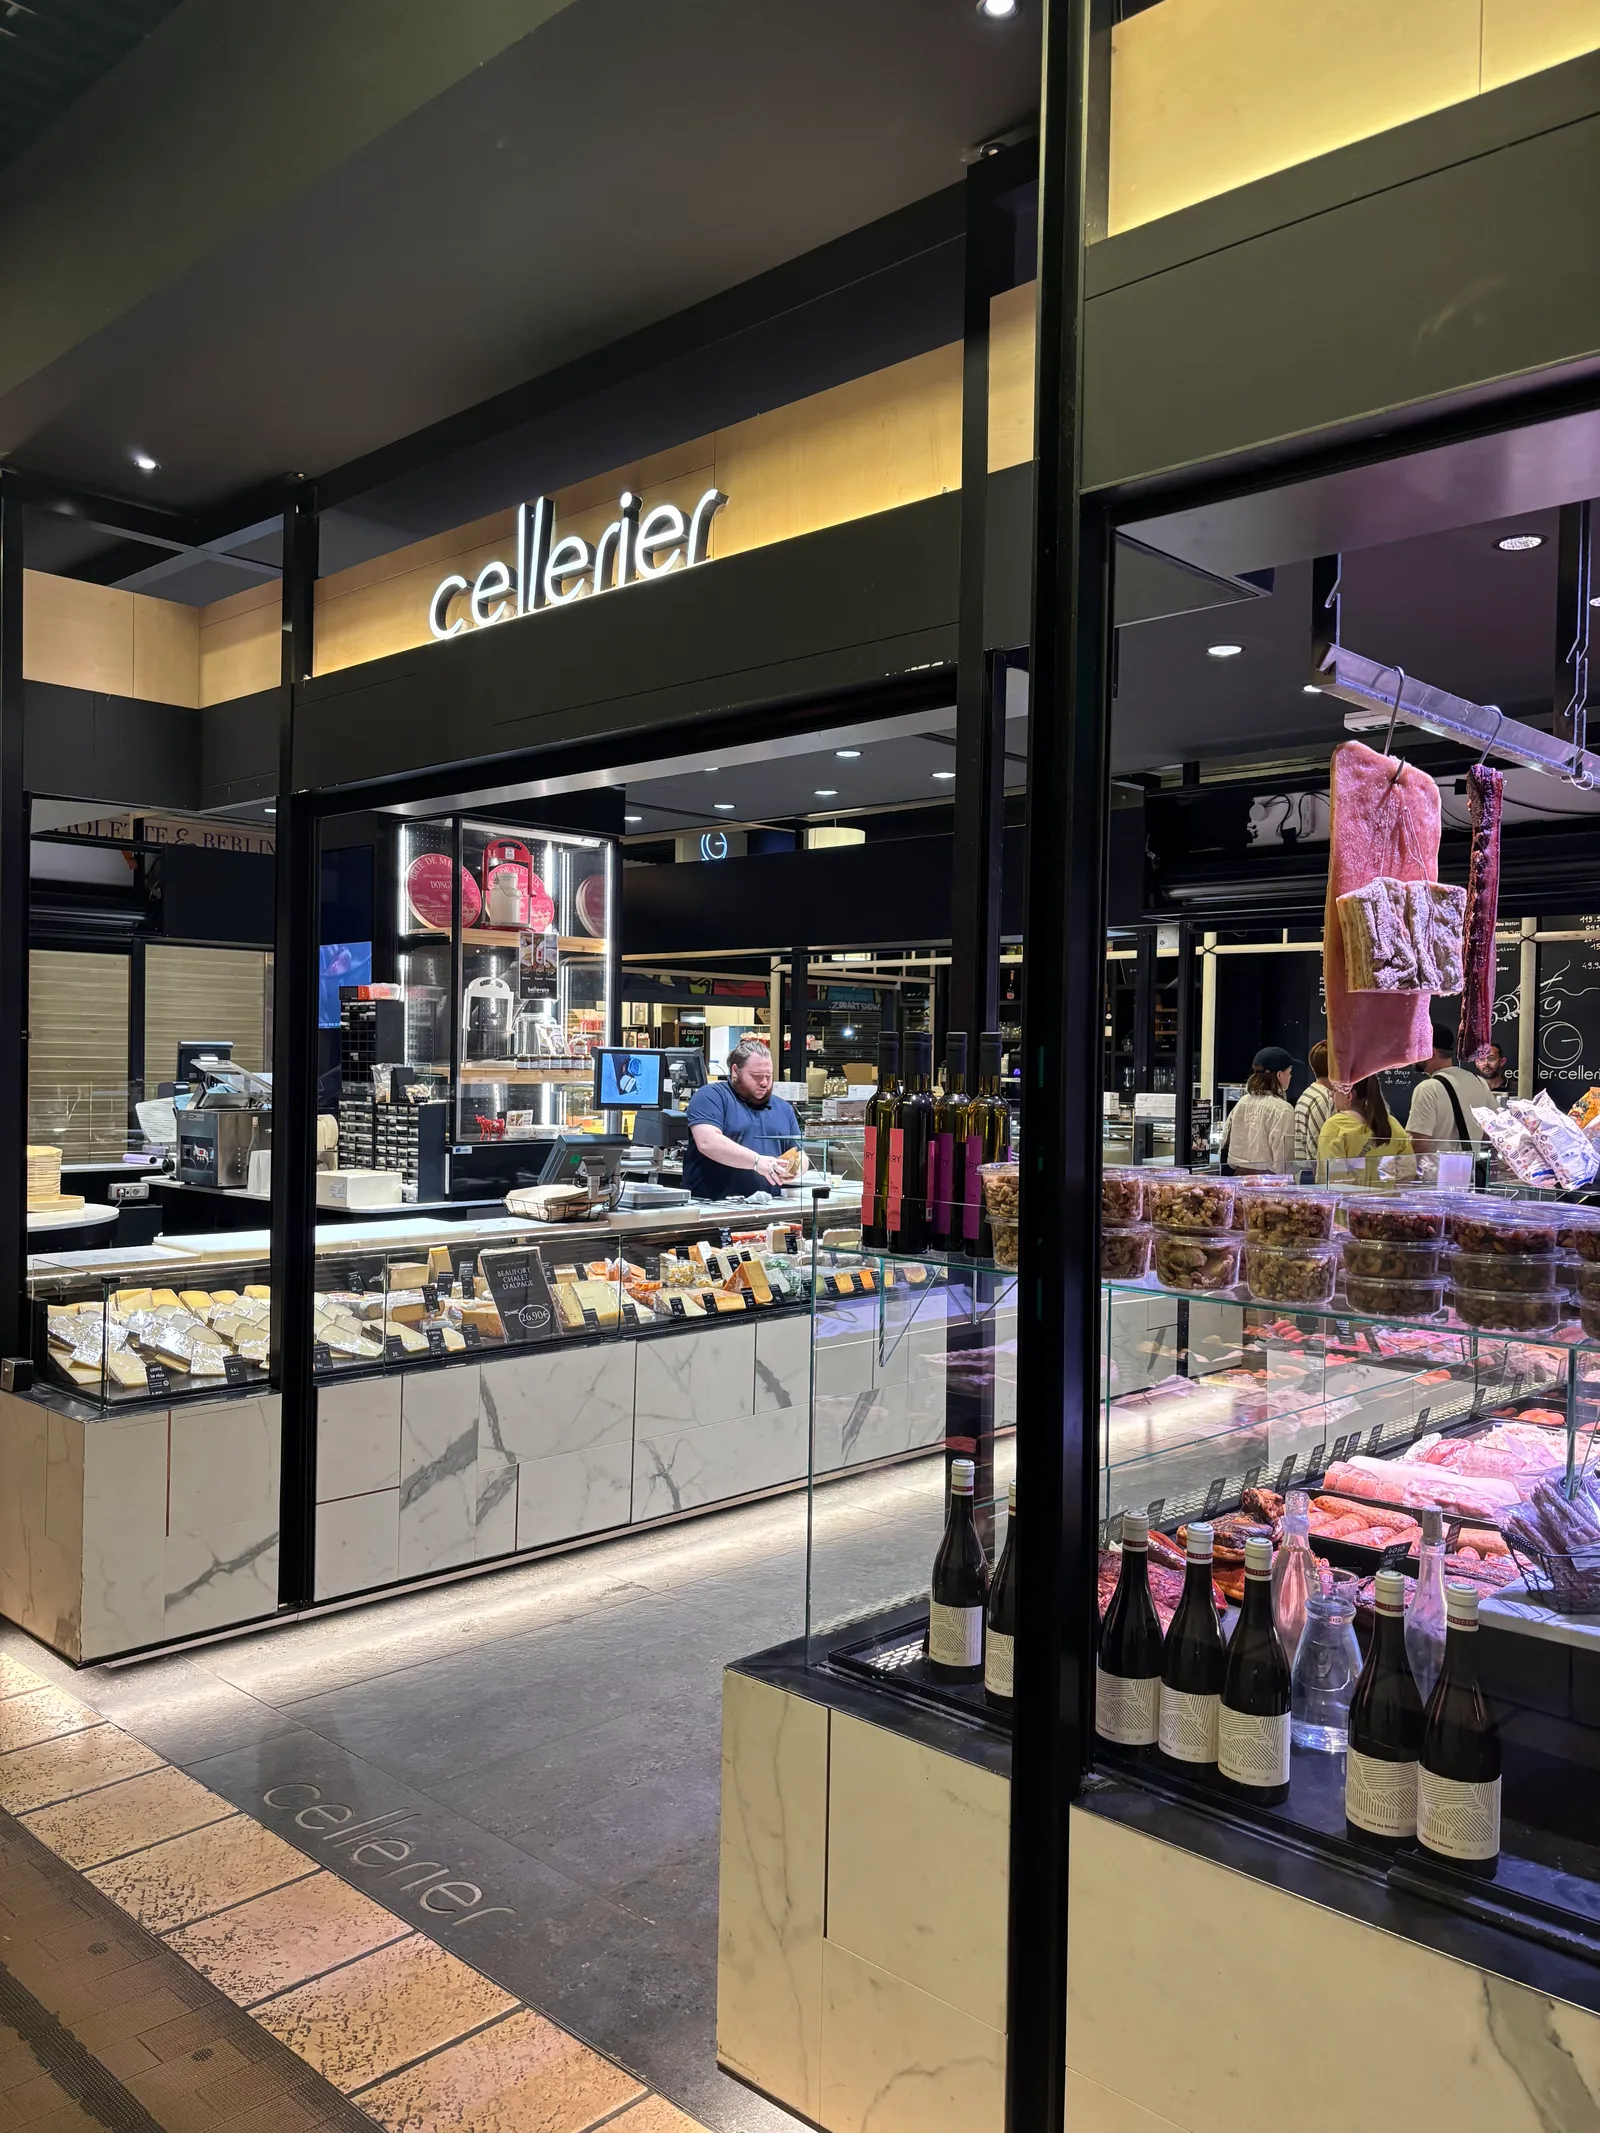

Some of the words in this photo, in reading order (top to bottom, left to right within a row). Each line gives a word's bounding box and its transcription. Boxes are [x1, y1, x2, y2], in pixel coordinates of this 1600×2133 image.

[429, 488, 728, 639] cellerier
[424, 856, 438, 866] DE
[497, 1267, 531, 1278] BEAUFORT
[503, 1274, 529, 1284] CHALET
[502, 1280, 535, 1291] D'ALPAGE
[520, 1310, 549, 1323] 26.90€
[263, 1781, 518, 1927] cellerier
